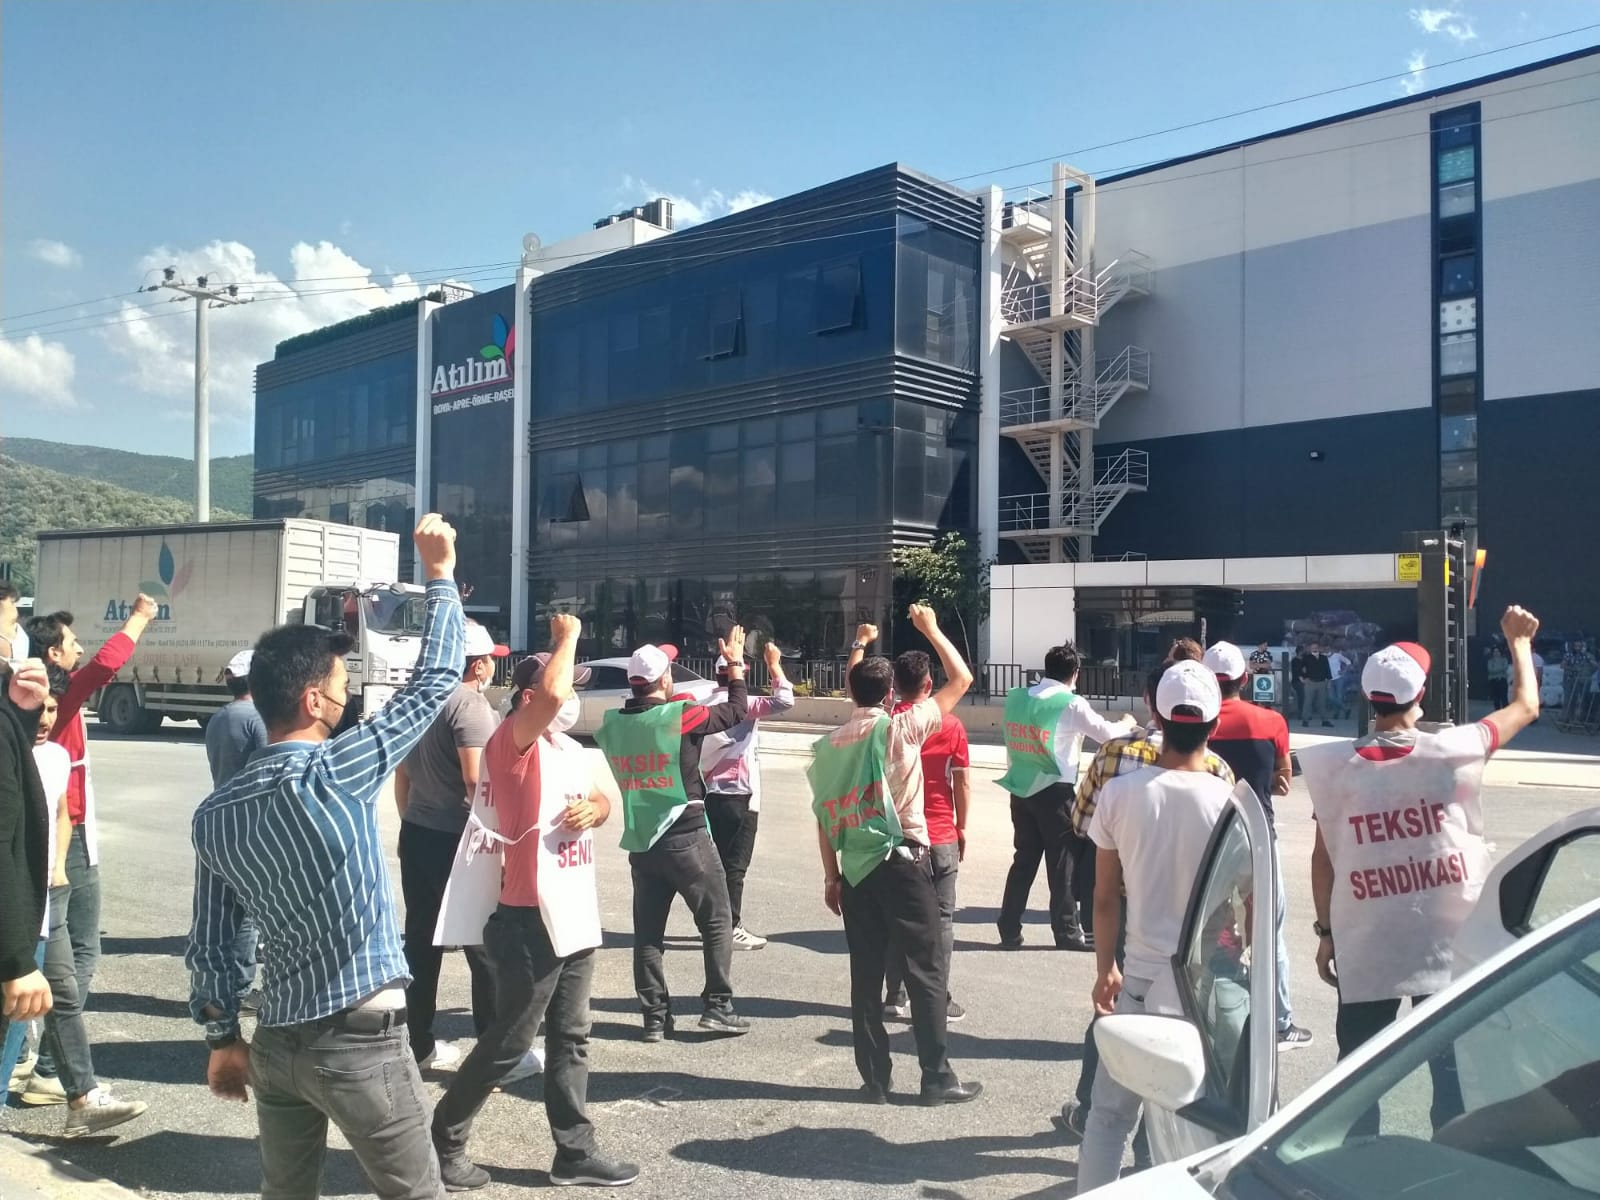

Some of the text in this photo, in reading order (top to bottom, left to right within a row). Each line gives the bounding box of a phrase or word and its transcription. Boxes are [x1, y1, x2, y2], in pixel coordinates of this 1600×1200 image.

[431, 357, 508, 394] Atılım
[1349, 799, 1445, 844] TEKSİF
[1350, 852, 1468, 900] SENDİKASI
